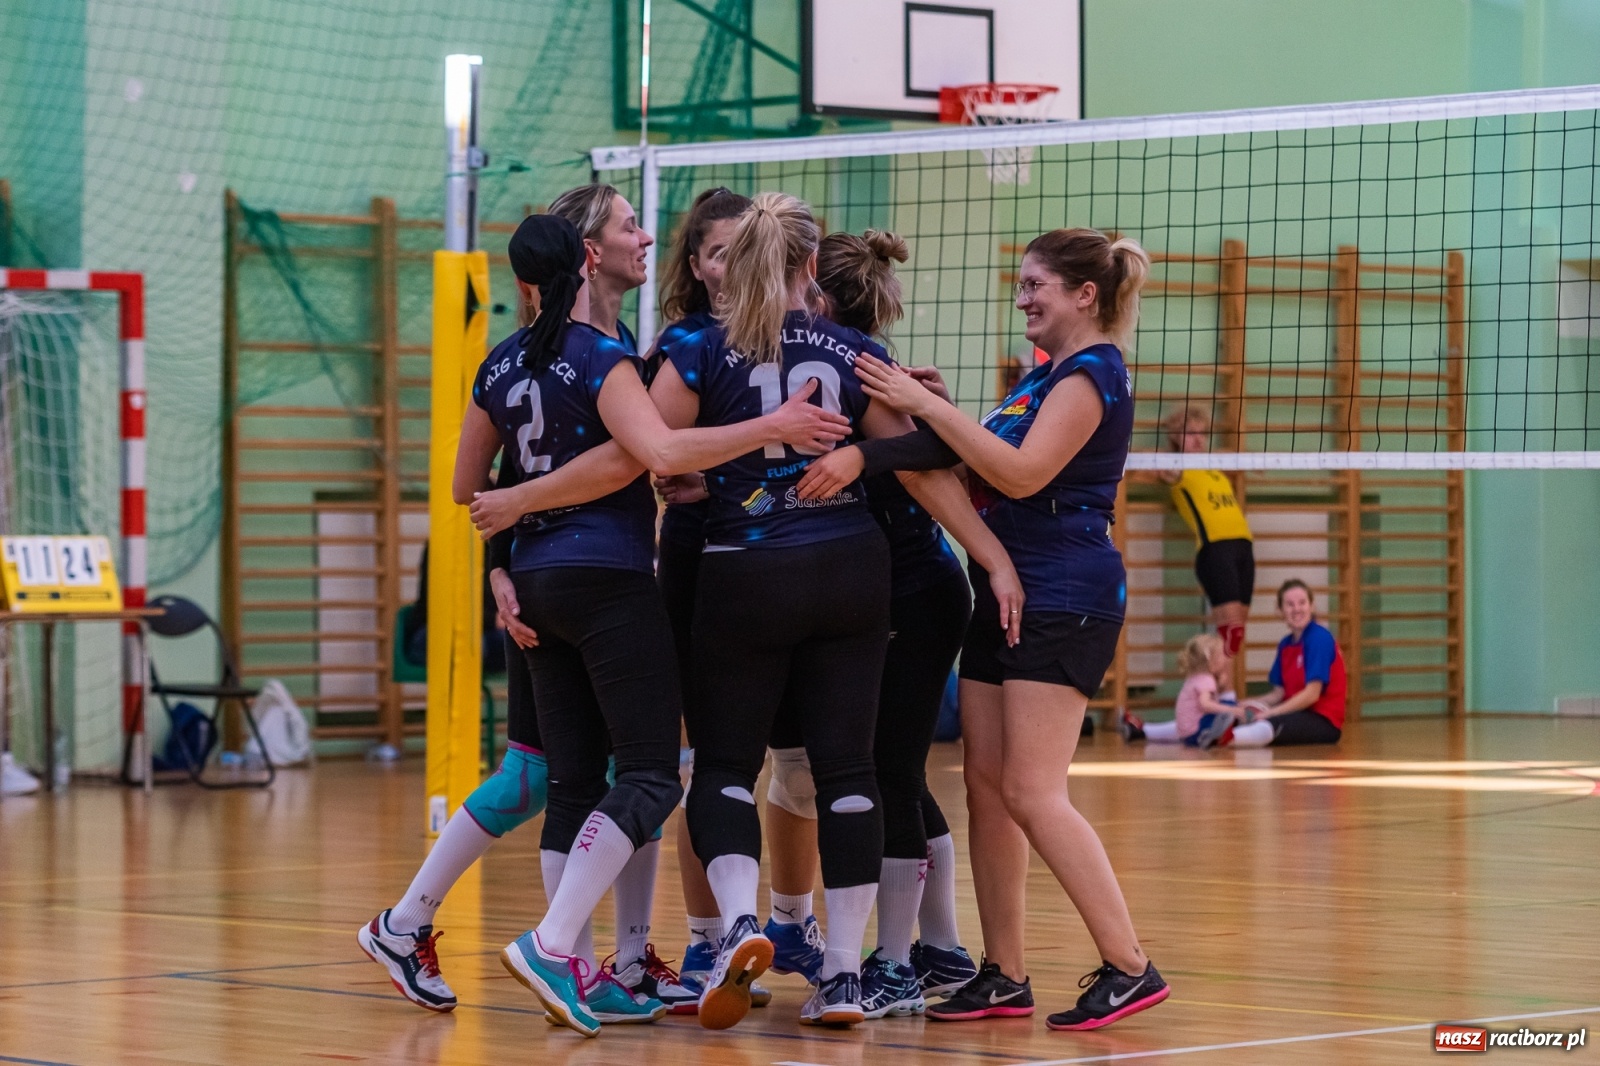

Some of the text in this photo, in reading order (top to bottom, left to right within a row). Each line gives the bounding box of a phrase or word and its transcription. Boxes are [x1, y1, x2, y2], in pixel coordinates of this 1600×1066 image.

[779, 328, 857, 367] LIWICE
[506, 378, 552, 473] 2
[749, 361, 842, 459] 10
[577, 812, 606, 853] LLSIX
